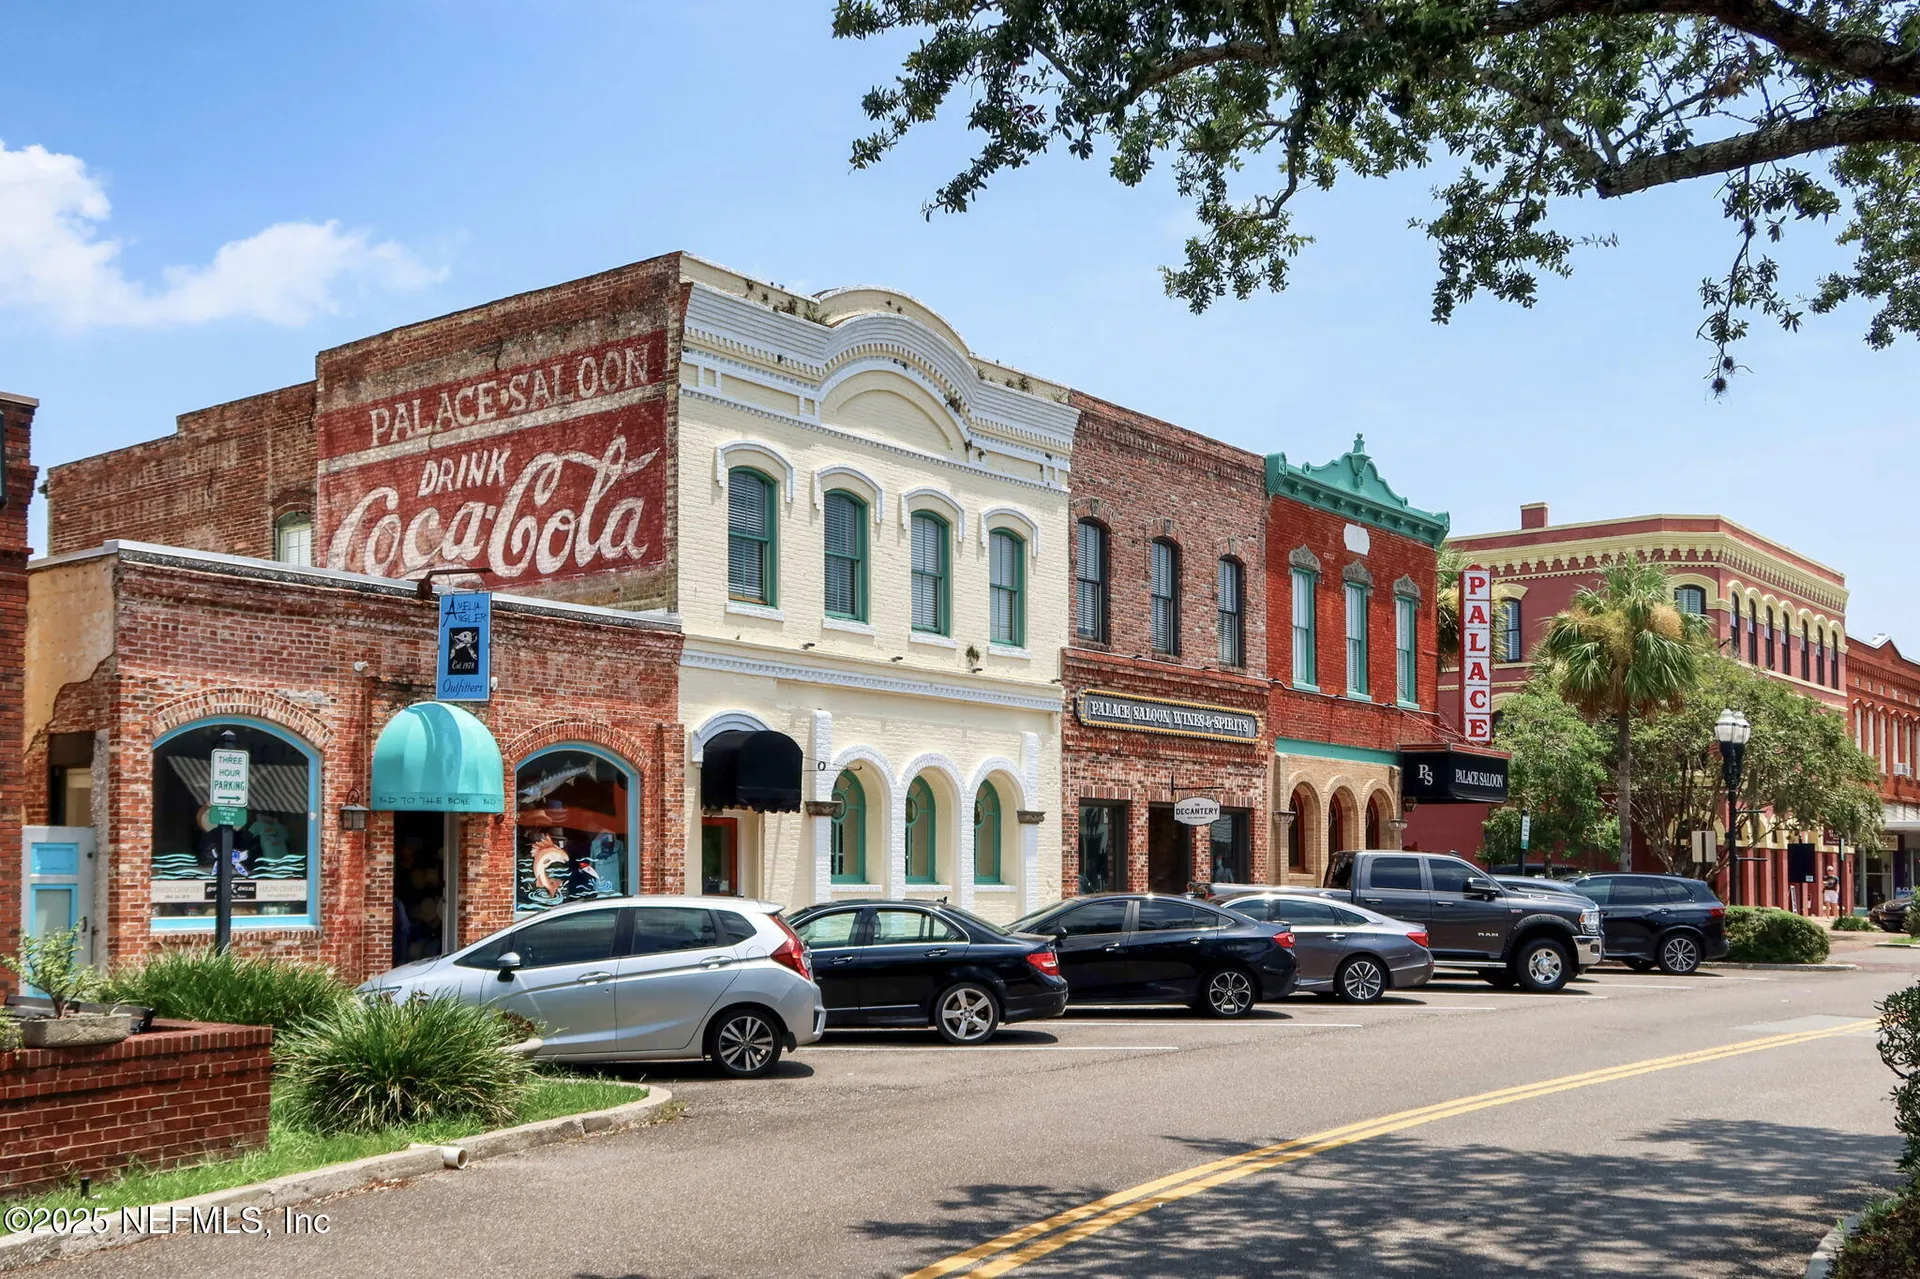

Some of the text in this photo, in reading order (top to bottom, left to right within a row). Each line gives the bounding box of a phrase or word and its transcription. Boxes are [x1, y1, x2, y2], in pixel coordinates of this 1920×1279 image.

[369, 345, 650, 446] PALACE SALOON
[417, 447, 511, 497] DRINK
[1468, 576, 1488, 738] PALACE
[442, 678, 483, 697] Outfitters
[1090, 701, 1131, 718] PALACE
[1133, 705, 1170, 723] SALOON
[1214, 716, 1249, 732] SPIRITS
[218, 756, 243, 765] THREE
[219, 769, 240, 777] HOUR
[1455, 769, 1504, 788] PALACE SALOON
[214, 780, 245, 791] PARKING
[400, 796, 415, 804] TO
[420, 796, 443, 805] THE
[1175, 807, 1219, 816] DECANTERY
